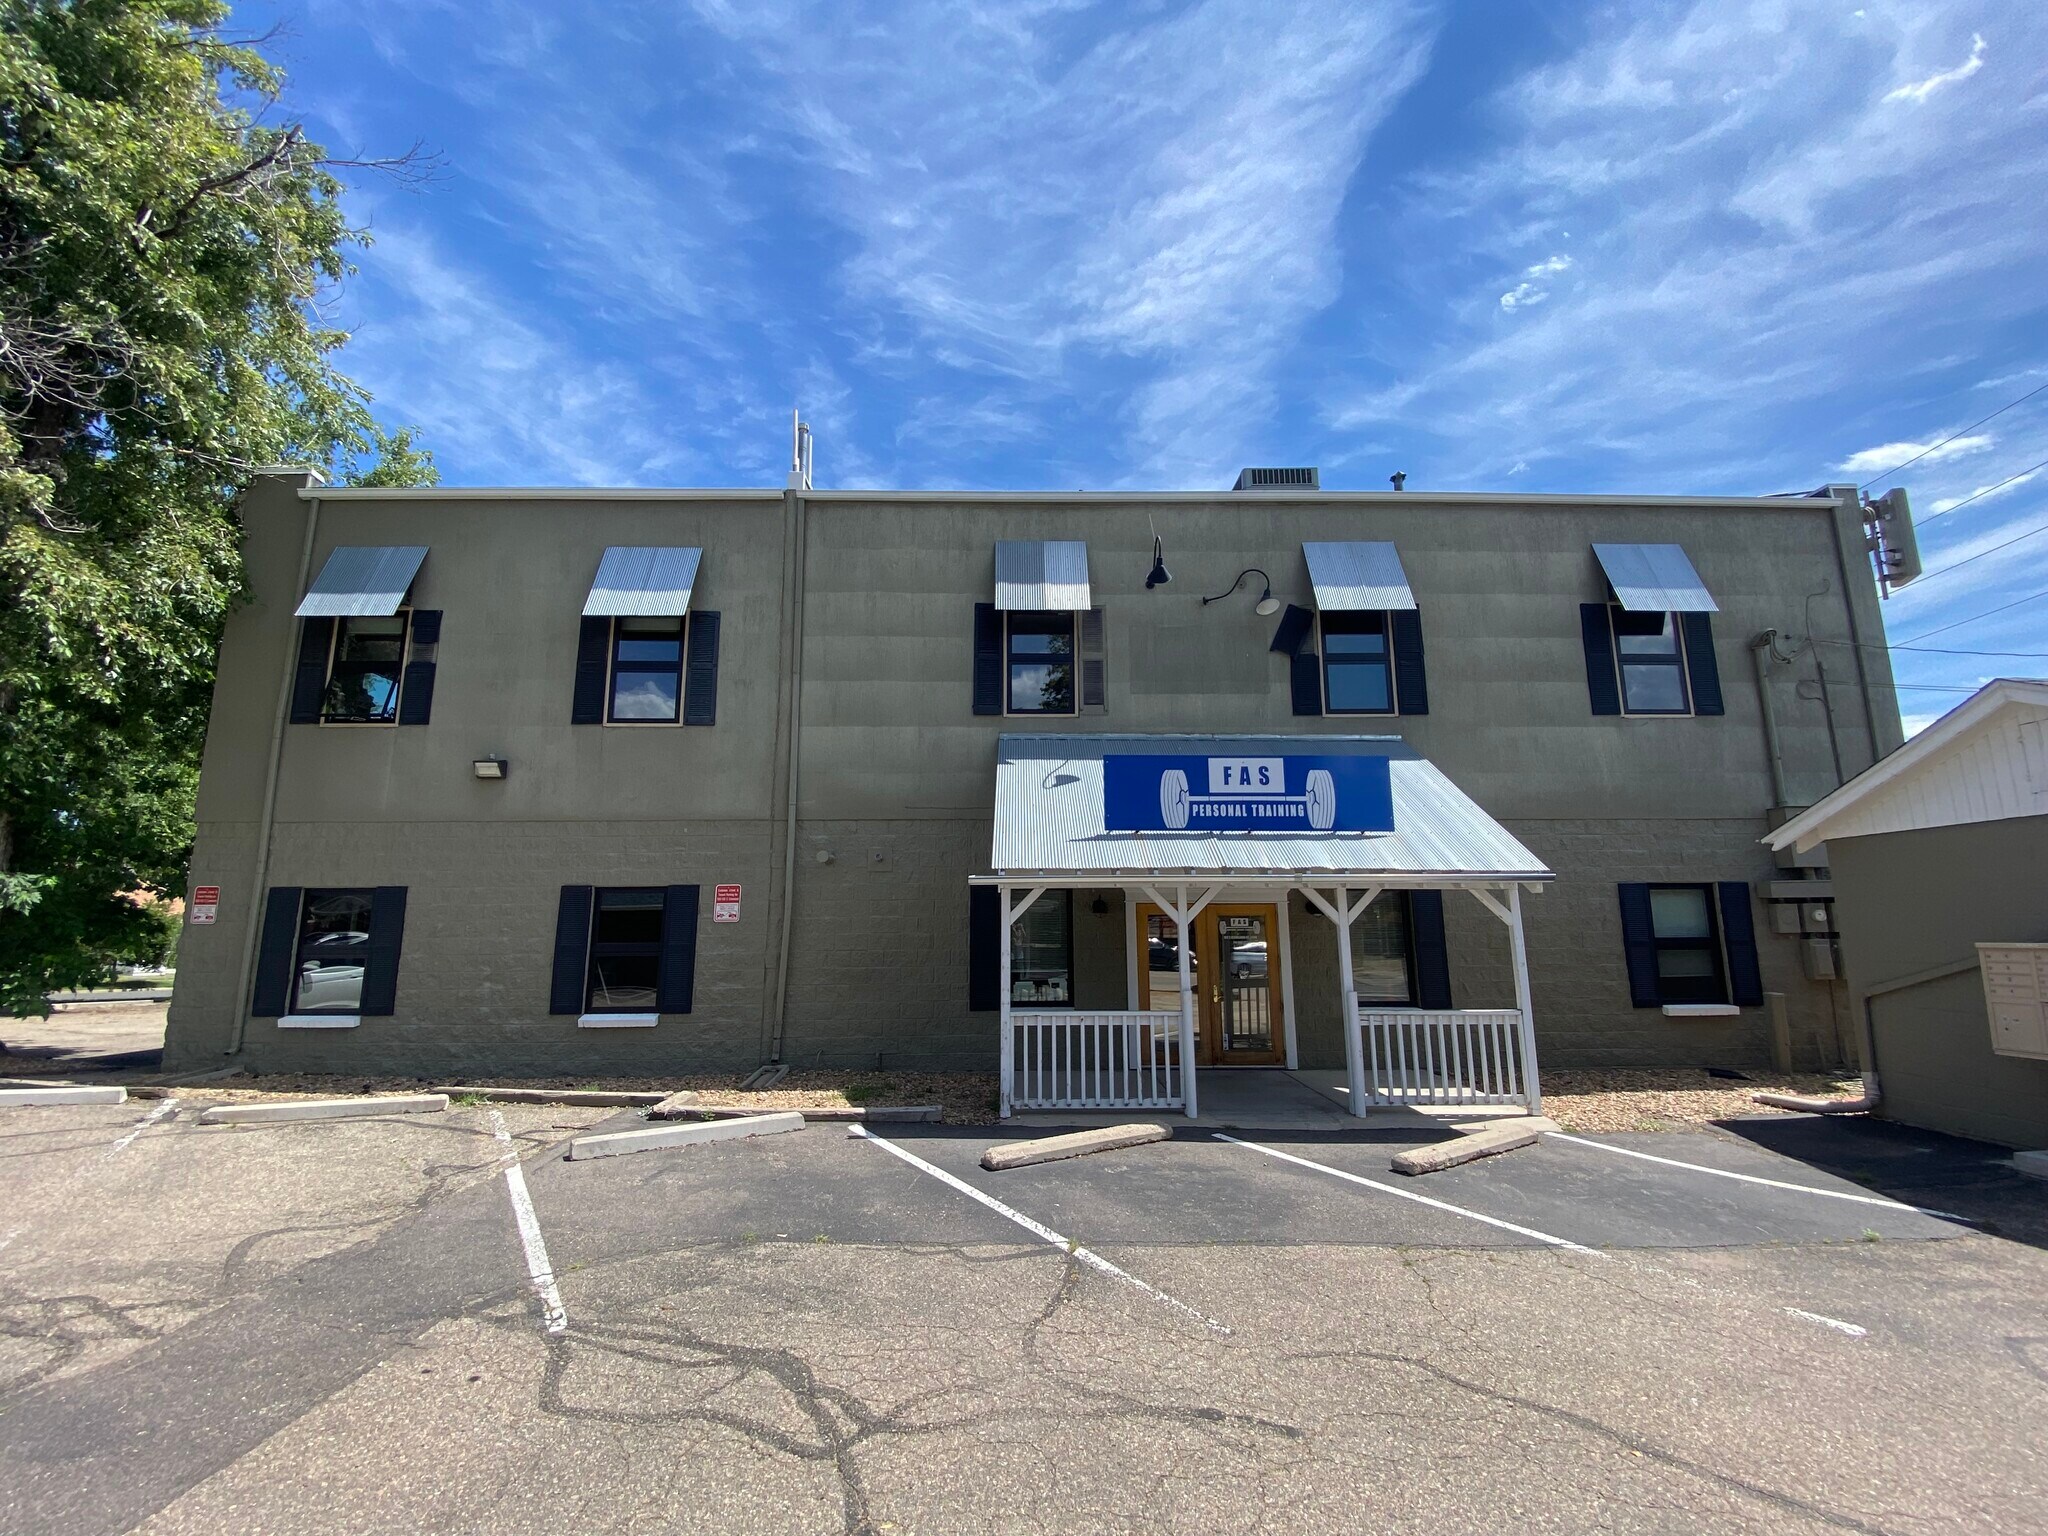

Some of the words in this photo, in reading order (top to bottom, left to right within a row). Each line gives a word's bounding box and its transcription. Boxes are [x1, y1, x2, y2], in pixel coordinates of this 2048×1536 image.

[1223, 765, 1270, 786] FAS
[1192, 804, 1248, 817] PERSONAL
[1251, 804, 1305, 817] TRAINING
